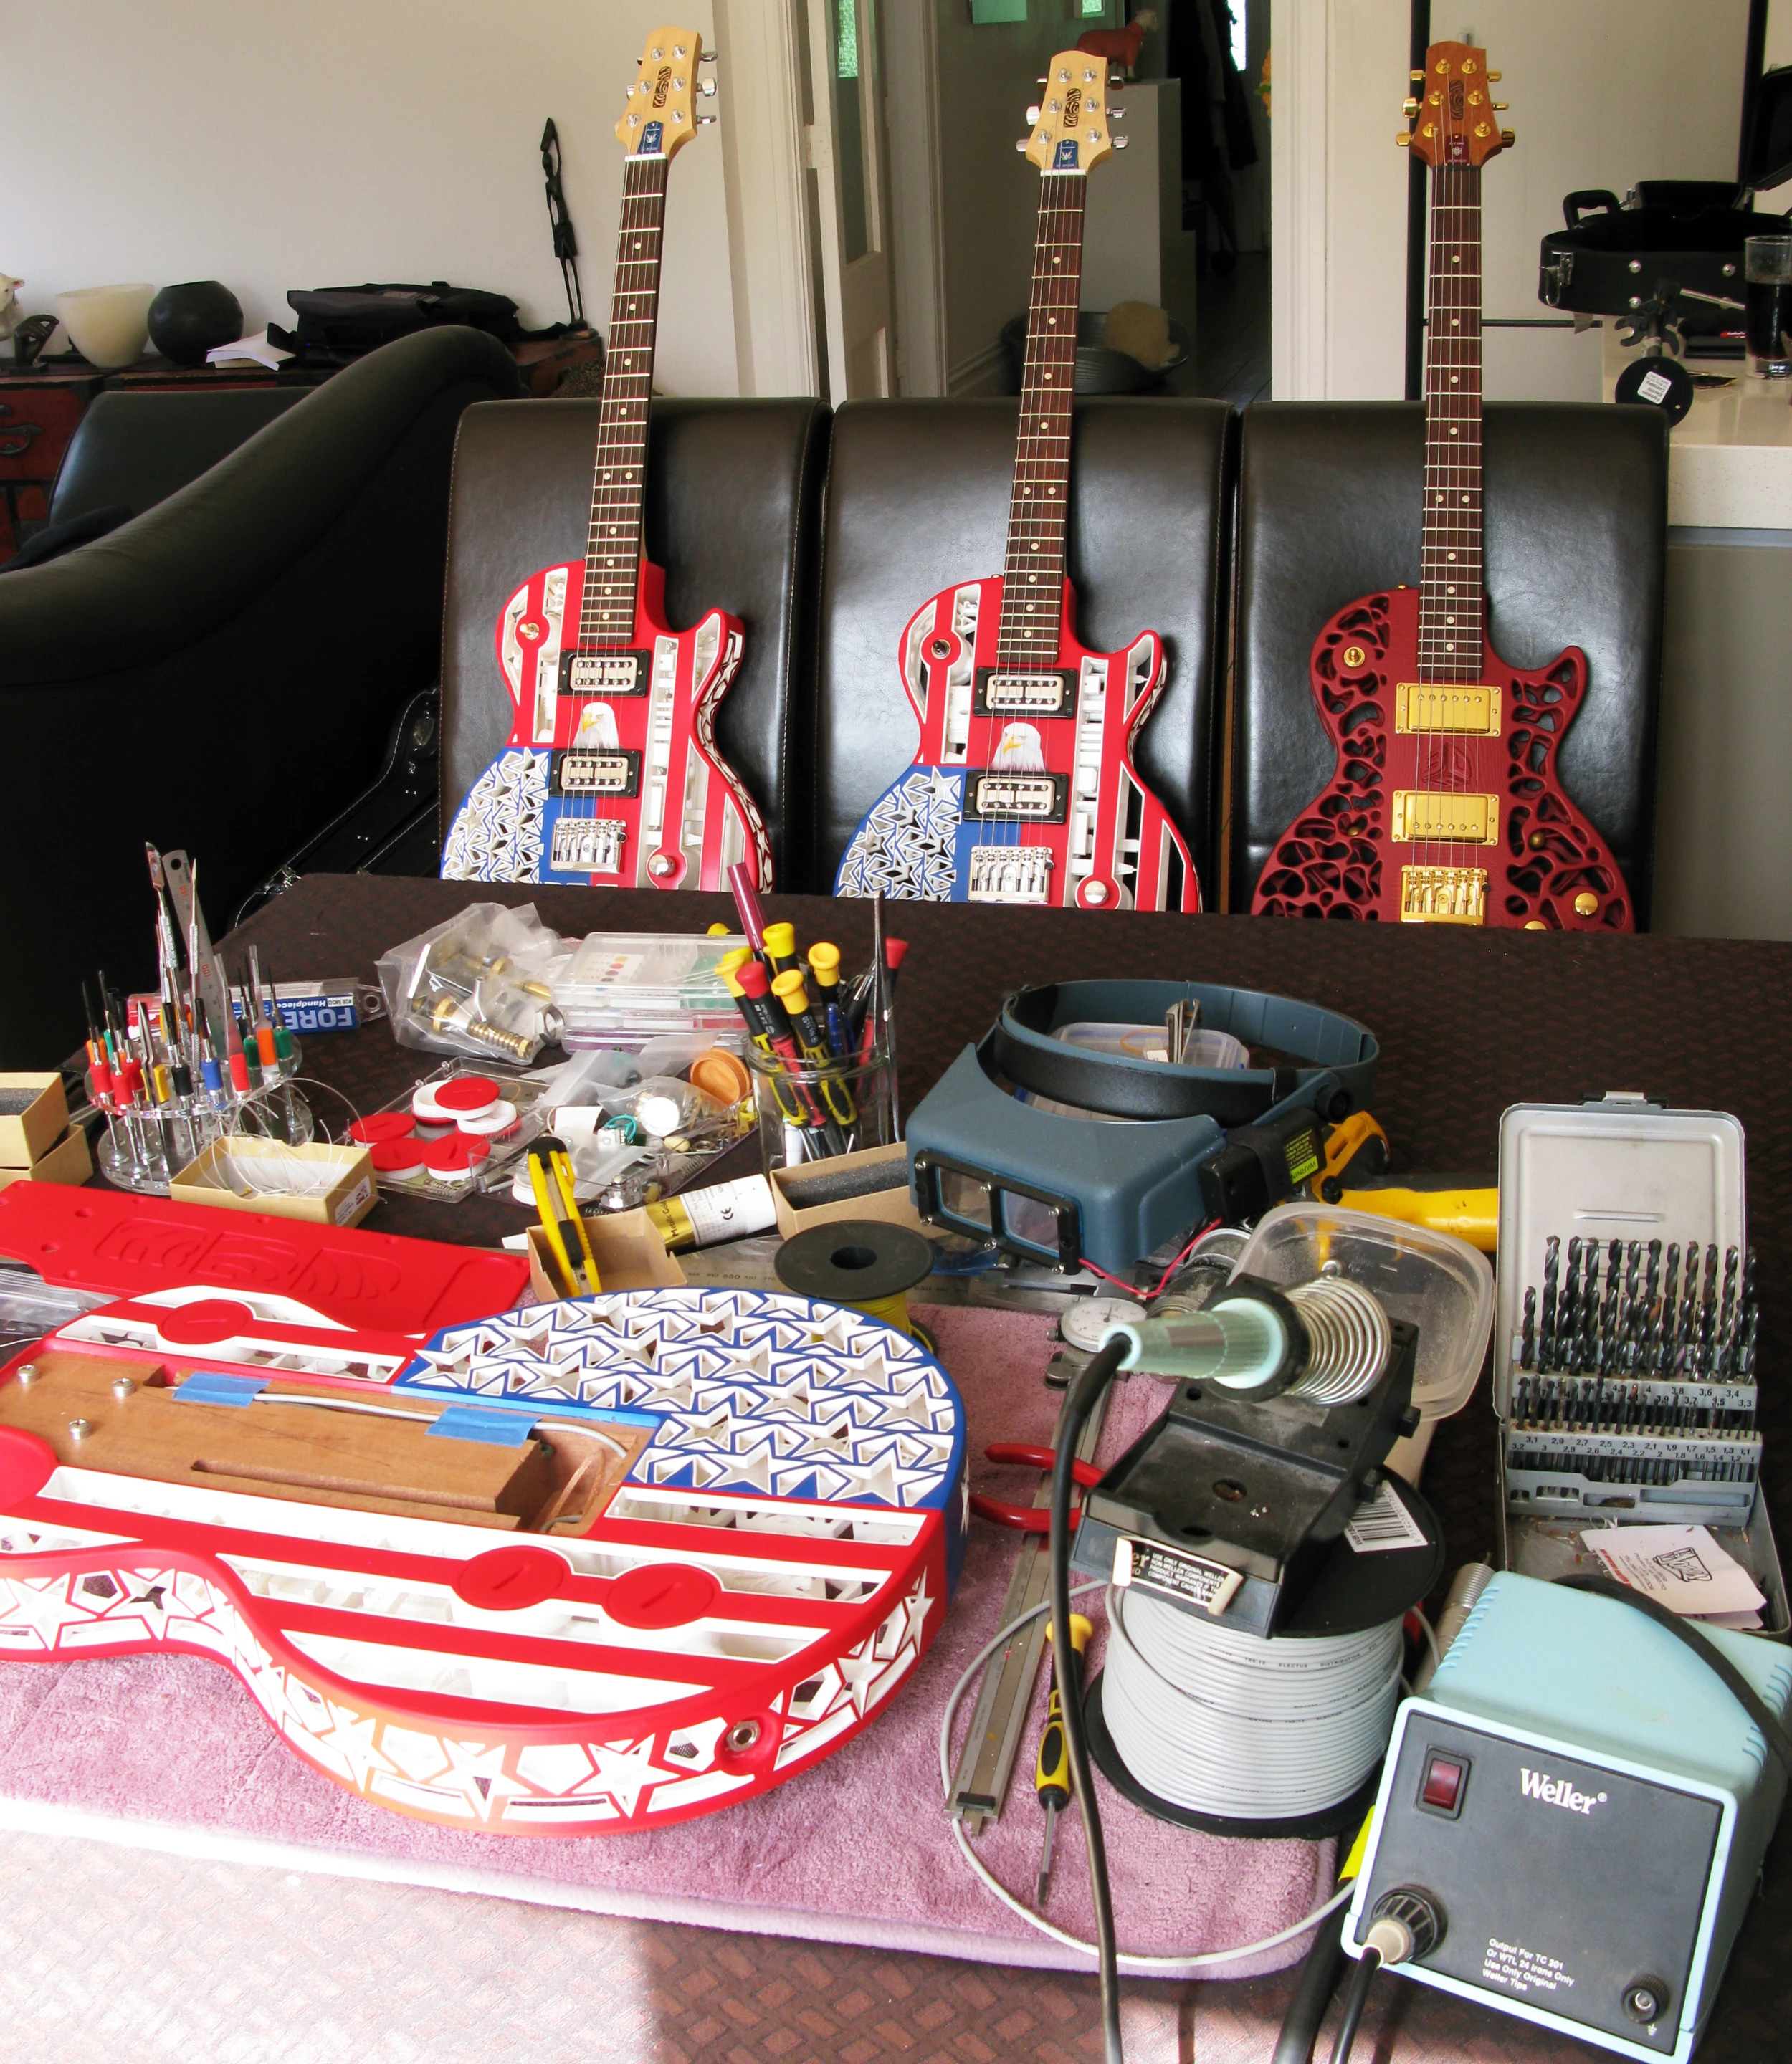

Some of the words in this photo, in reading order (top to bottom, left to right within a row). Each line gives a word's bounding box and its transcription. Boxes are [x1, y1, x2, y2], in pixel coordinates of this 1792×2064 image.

[277, 1000, 326, 1009] Handpiece
[282, 1008, 353, 1030] FORE
[1292, 1161, 1317, 1179] WARNIN
[1684, 1397, 1697, 1405] 3,7
[1133, 1552, 1150, 1568] er
[1153, 1553, 1163, 1562] USE
[1164, 1556, 1178, 1565] ONLY
[1178, 1560, 1202, 1574] ORIGINAL
[1148, 1572, 1179, 1585] COMPONENT
[1150, 1565, 1173, 1577] PRODUCT
[1175, 1573, 1204, 1587] WARRANTY
[1185, 1569, 1219, 1587] COMPONENTS
[1520, 1767, 1597, 1815] Weller
[1489, 1938, 1517, 1954] Output
[1519, 1948, 1534, 1960] For
[1535, 1954, 1548, 1964] TC
[1548, 1959, 1563, 1970] 201
[1484, 1958, 1501, 1971] Use
[1502, 1964, 1522, 1979] Only
[1523, 1972, 1556, 1990] Original
[1487, 1948, 1497, 1958] Or
[1499, 1951, 1517, 1966] WTL
[1519, 1959, 1530, 1969] 24
[1530, 1963, 1553, 1978] Irons
[1554, 1972, 1575, 1987] Only
[1482, 1968, 1508, 1984] Weller
[1510, 1977, 1528, 1991] Tips
